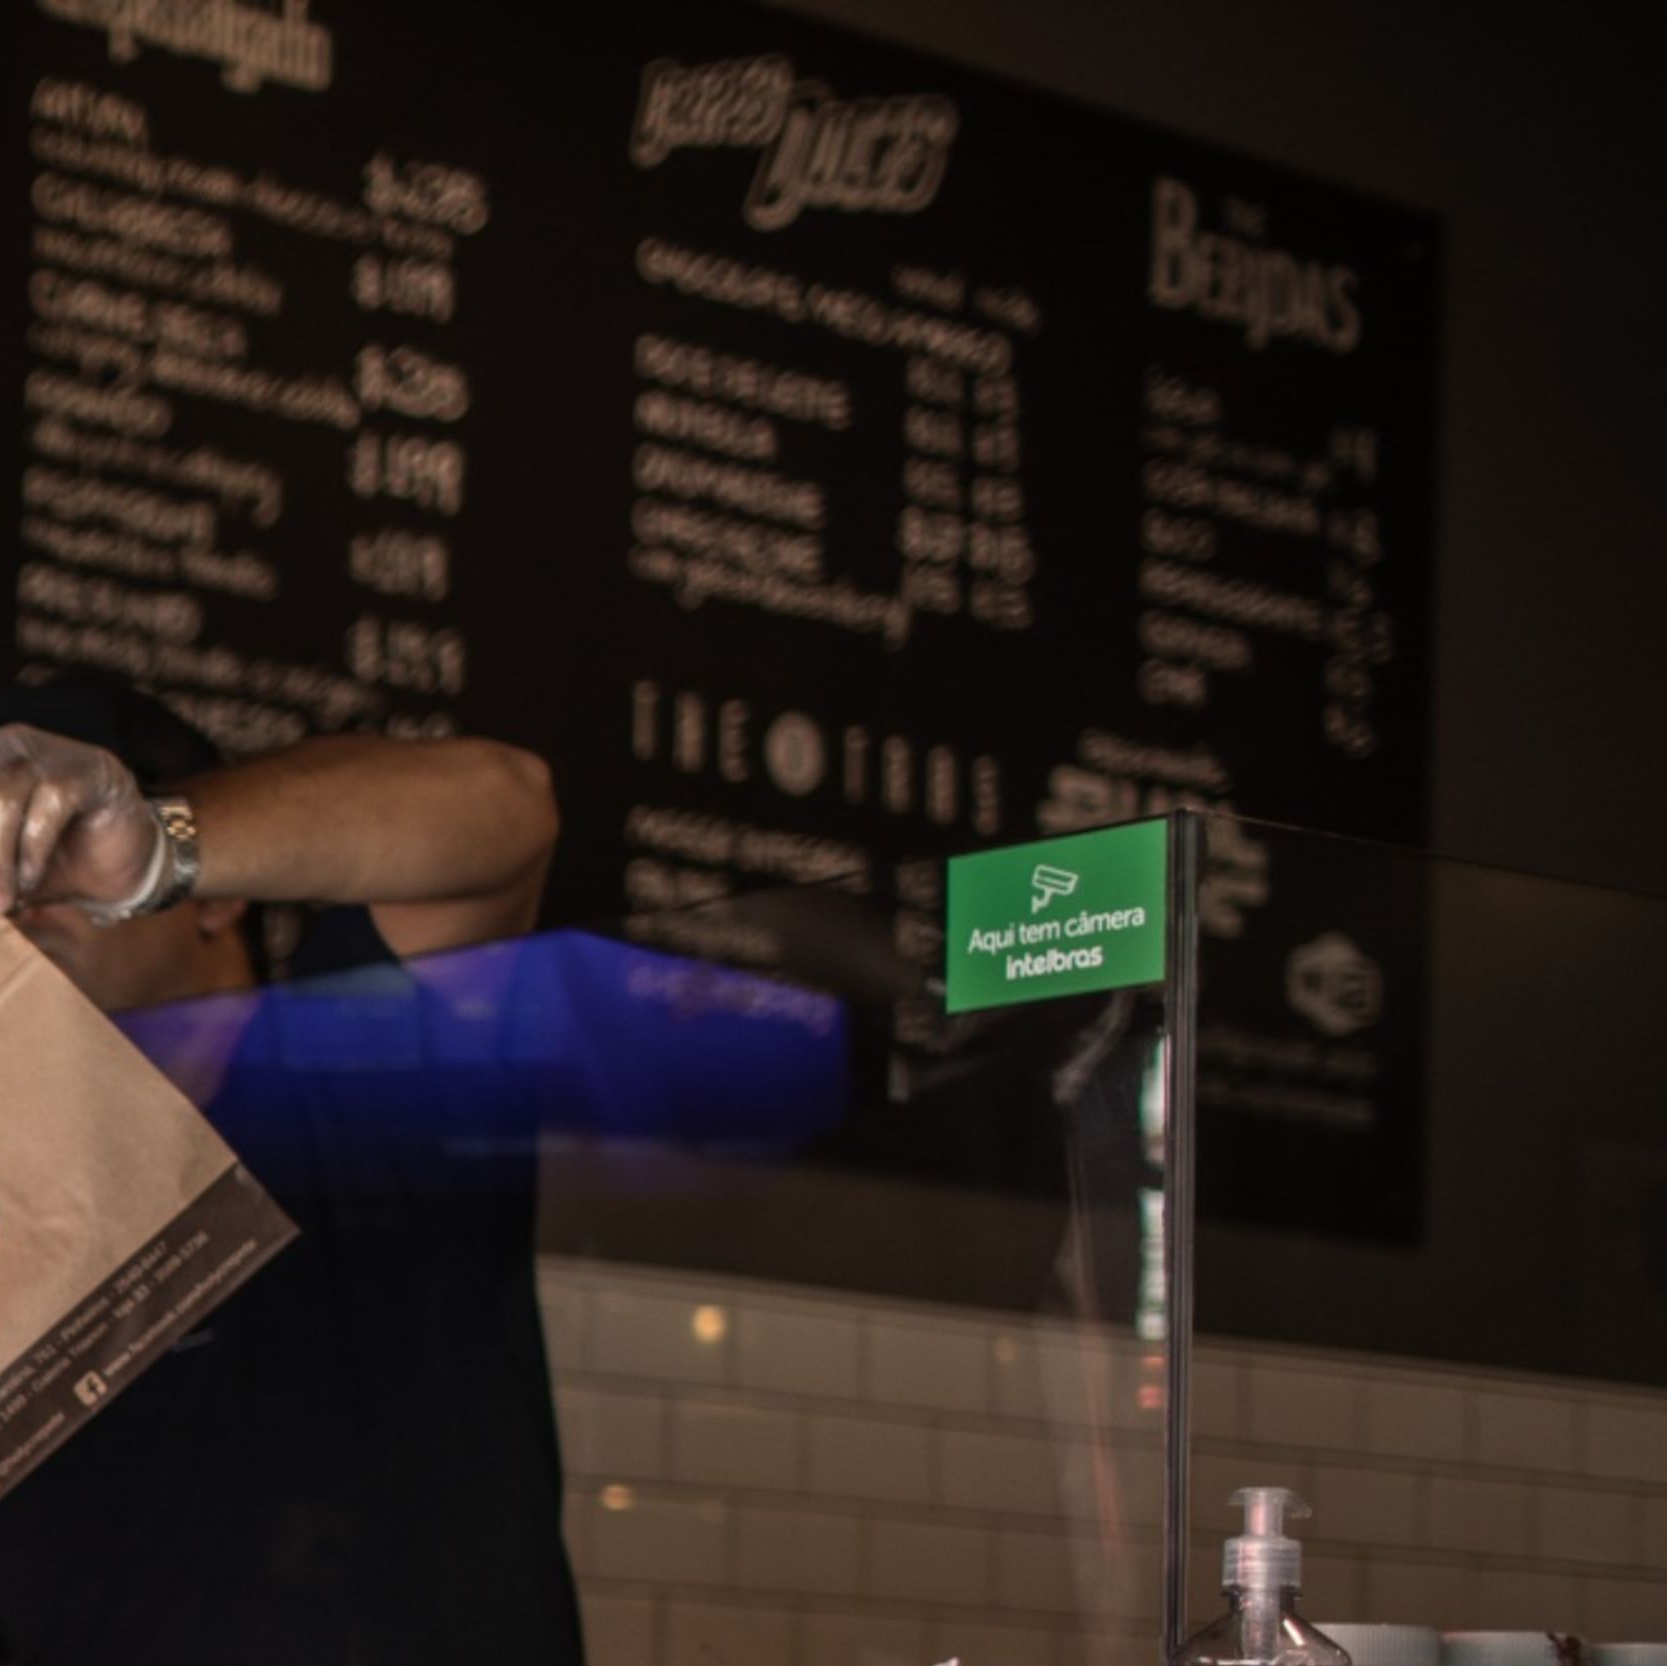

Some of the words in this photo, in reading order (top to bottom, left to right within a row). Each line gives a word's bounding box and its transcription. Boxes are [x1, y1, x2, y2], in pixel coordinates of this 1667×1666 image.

[968, 923, 1015, 955] Aqui
[1020, 922, 1061, 945] tem
[1065, 907, 1146, 937] câmera
[1006, 946, 1103, 980] intelbras
